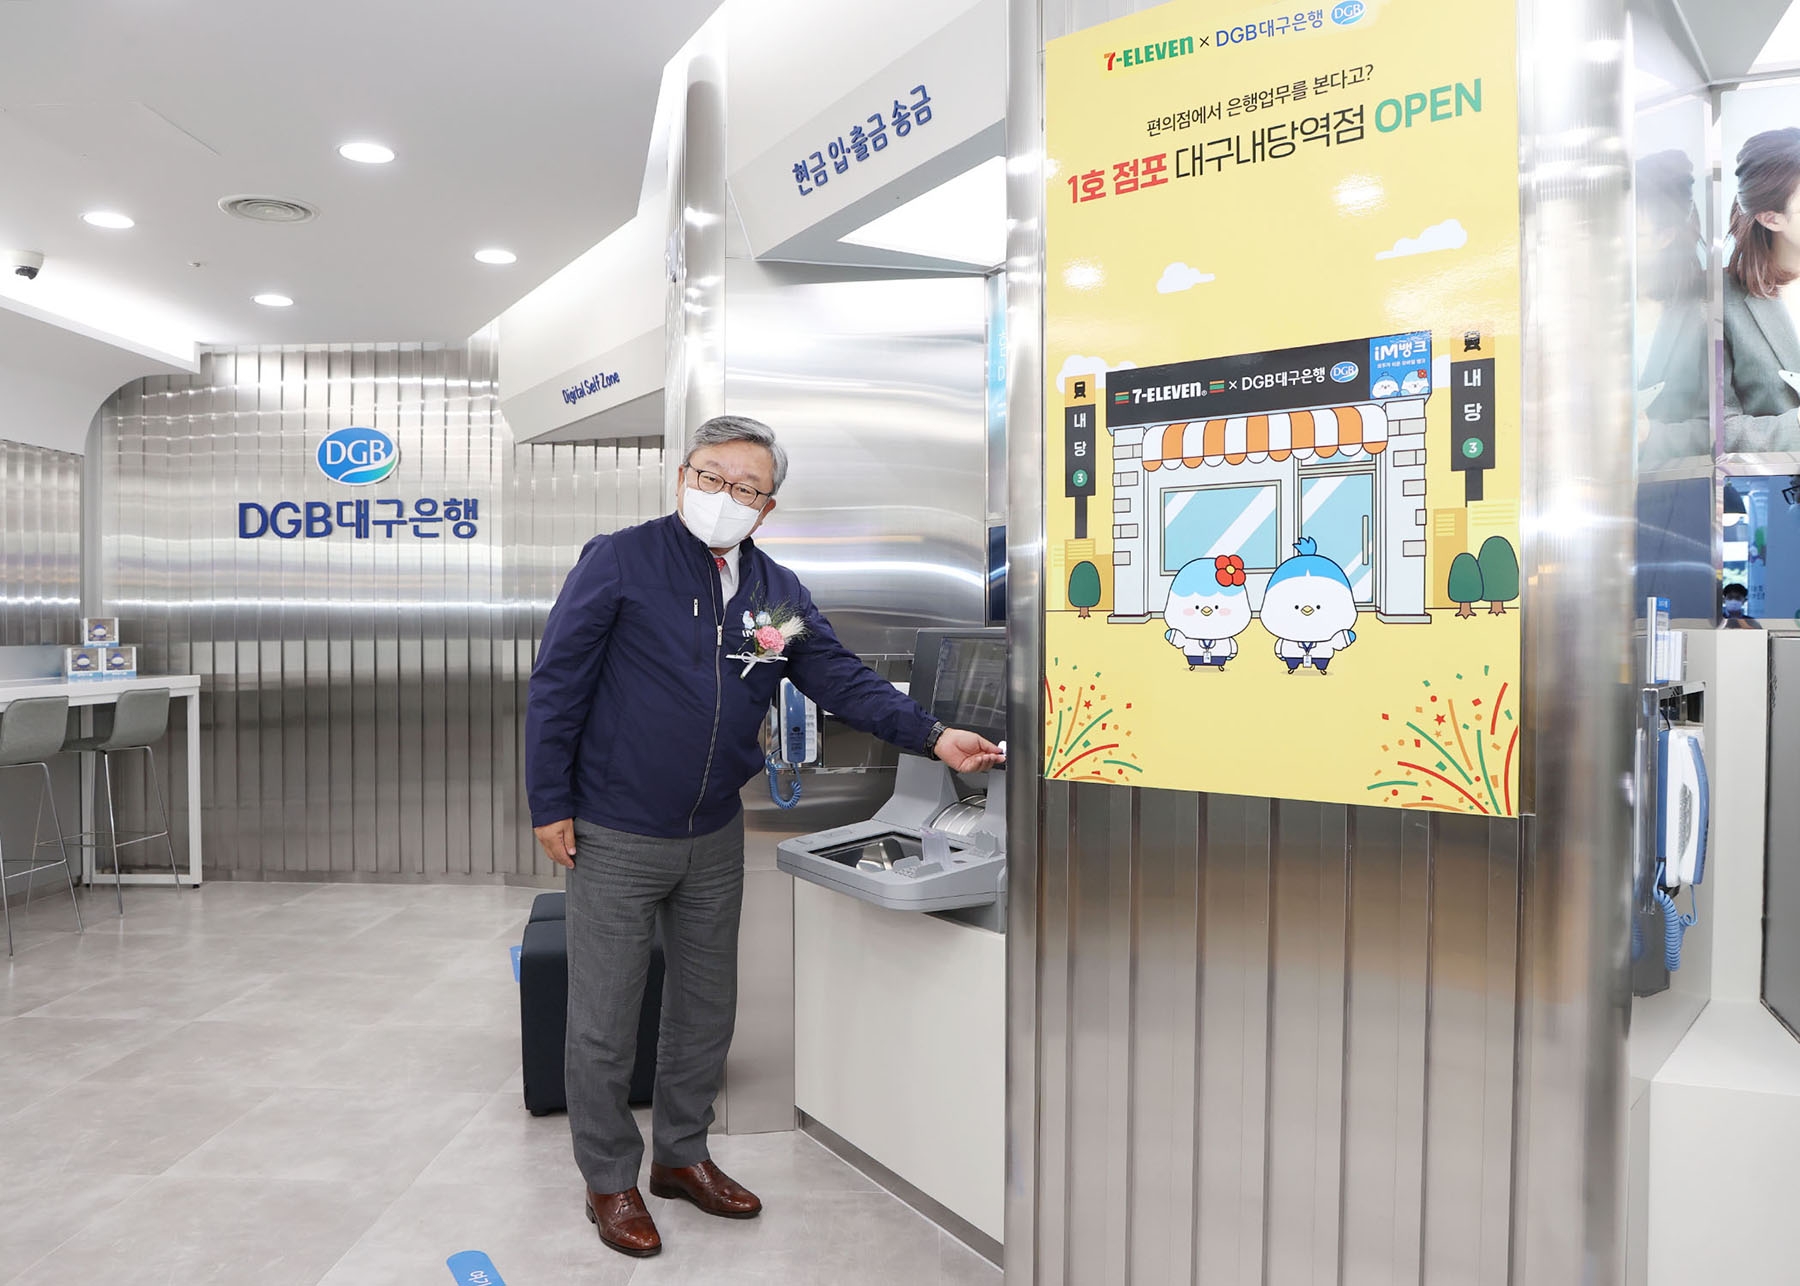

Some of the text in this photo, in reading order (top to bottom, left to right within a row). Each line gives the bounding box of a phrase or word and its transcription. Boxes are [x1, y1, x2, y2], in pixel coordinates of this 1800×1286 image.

[1215, 9, 1323, 47] DGB대구은행
[1333, 2, 1365, 19] DGB
[1146, 64, 1374, 137] 편의점에서 은행업무를 본다고?
[792, 151, 828, 196] 현금
[891, 84, 932, 137] 송금
[1067, 78, 1482, 204] 1호 점포 대구내당역점 OPEN
[562, 372, 620, 405] Digital Self Zone
[1241, 367, 1326, 391] DGB대구은행
[1332, 365, 1356, 377] DGB
[325, 440, 387, 465] DGB
[1468, 442, 1478, 453] 3
[1077, 473, 1084, 483] 3
[238, 498, 479, 539] DGB대구은행
